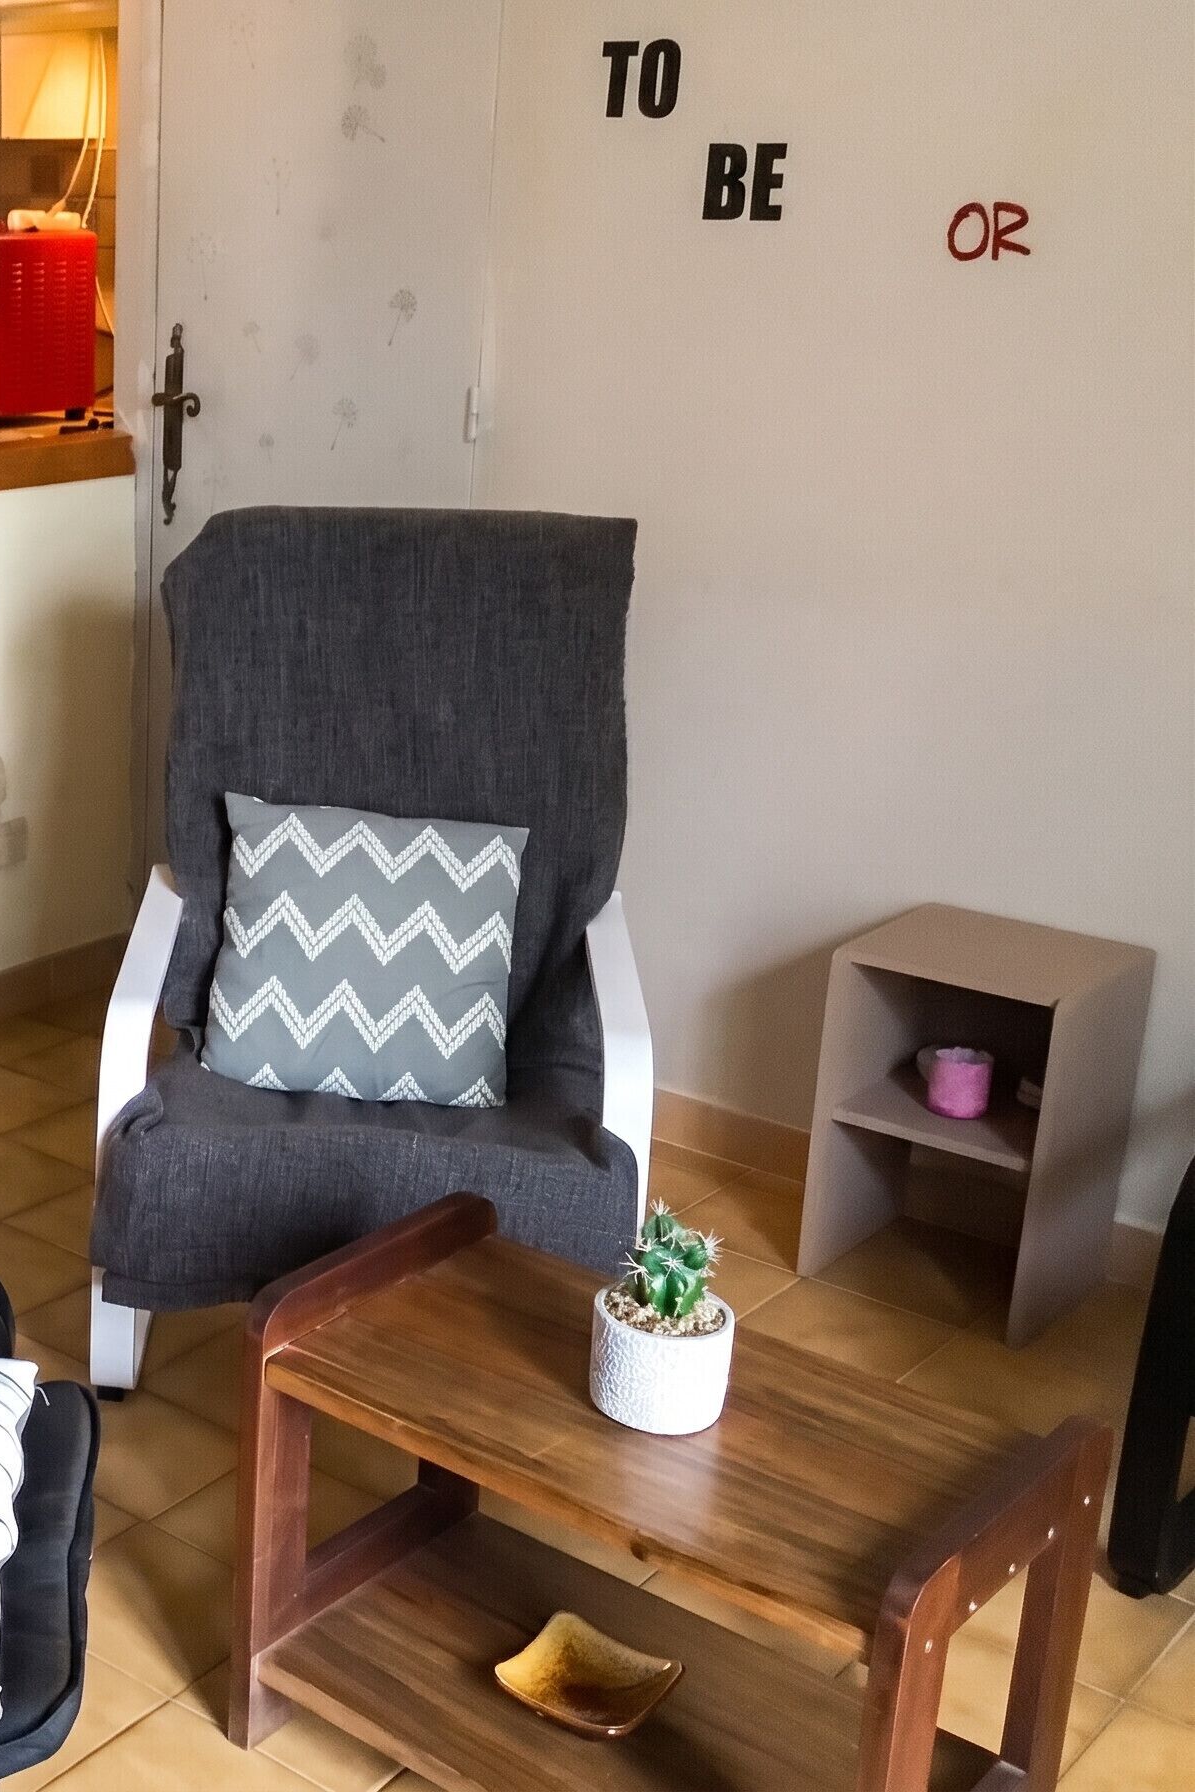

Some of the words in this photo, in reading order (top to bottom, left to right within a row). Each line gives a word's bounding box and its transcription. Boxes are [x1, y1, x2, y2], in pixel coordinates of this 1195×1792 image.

[602, 38, 682, 118] TO
[702, 142, 788, 221] BE
[947, 202, 1031, 261] OR
